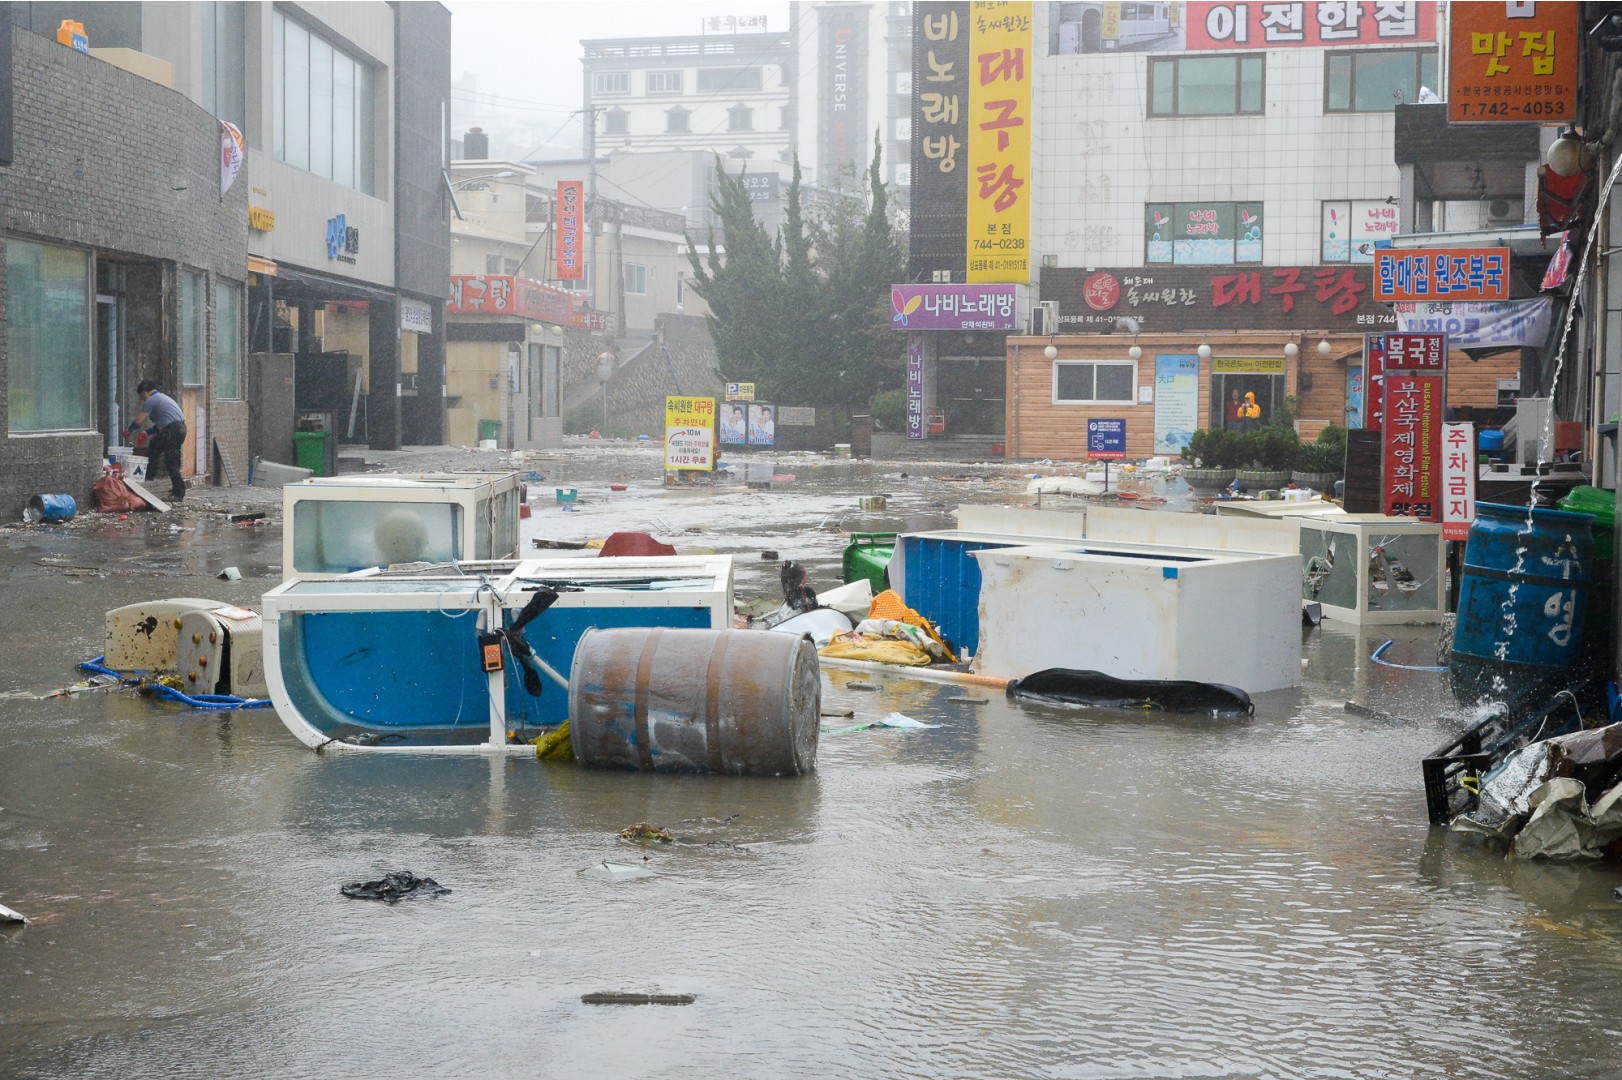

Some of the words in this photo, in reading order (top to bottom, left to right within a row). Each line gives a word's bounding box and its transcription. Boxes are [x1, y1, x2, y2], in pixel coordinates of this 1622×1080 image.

[1204, 2, 1417, 43] 이전한집
[1471, 30, 1556, 77] 맛집
[834, 27, 853, 112] UNIVERSE
[977, 47, 1025, 213] 대구탕
[1189, 210, 1217, 222] 나비
[1364, 220, 1399, 232] 노래방
[1367, 208, 1396, 219] 나비
[1186, 222, 1219, 235] 노래방
[973, 238, 1025, 250] 744-0238
[1379, 255, 1430, 295] 할매집
[1434, 254, 1504, 294] 원조복국
[924, 293, 1015, 317] 나비노래방
[1209, 266, 1367, 316] 대구탕
[1387, 338, 1427, 365] 복국
[1428, 337, 1440, 365] 전문
[909, 354, 922, 429] 나비노래방
[1423, 382, 1431, 411] BUSAN
[694, 400, 713, 415] 대구탕
[674, 418, 707, 427] 주차안내
[1391, 382, 1421, 498] 부산국제영화제
[1421, 472, 1430, 498] Festival
[1447, 429, 1468, 519] 주차금지
